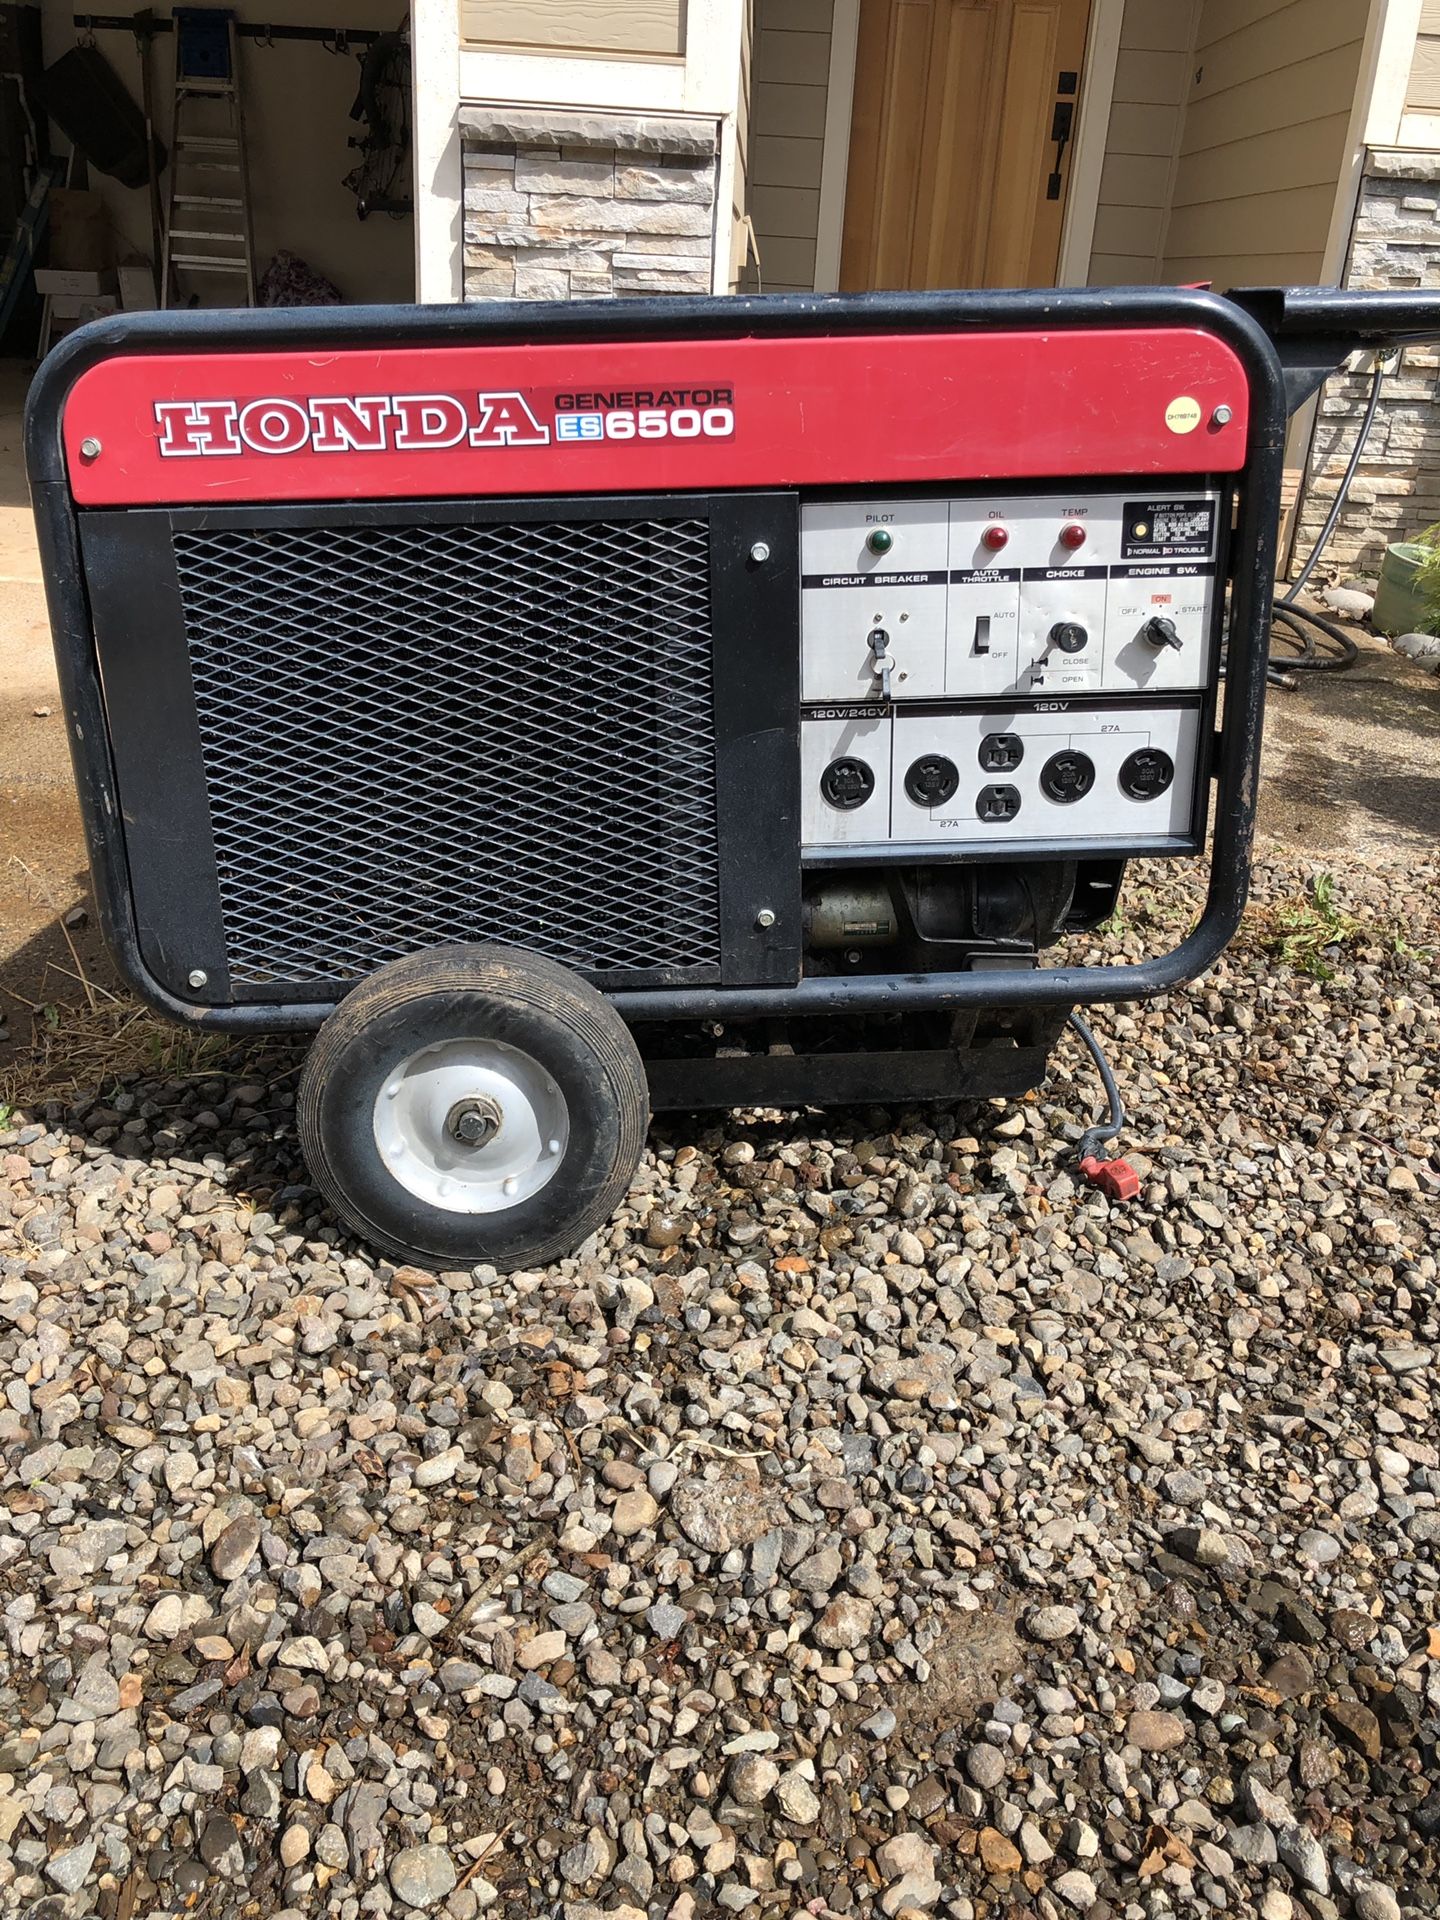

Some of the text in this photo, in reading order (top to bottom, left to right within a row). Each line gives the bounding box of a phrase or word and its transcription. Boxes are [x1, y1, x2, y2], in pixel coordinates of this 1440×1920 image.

[554, 389, 733, 411] GENERATOR
[153, 392, 551, 457] HONDA
[1061, 508, 1088, 517] TEMP
[1147, 504, 1172, 512] ALERT
[866, 514, 895, 523] PILOT
[988, 511, 1004, 519] OIL
[1174, 546, 1206, 554] TROUBLE
[1046, 570, 1085, 578] CHOKE
[1128, 566, 1198, 575] ENGINE SW.
[822, 575, 929, 586] CIRCUIT BREAKER
[962, 575, 1009, 583] THROTTLE
[1182, 605, 1207, 613] START
[1033, 702, 1069, 712] 120V
